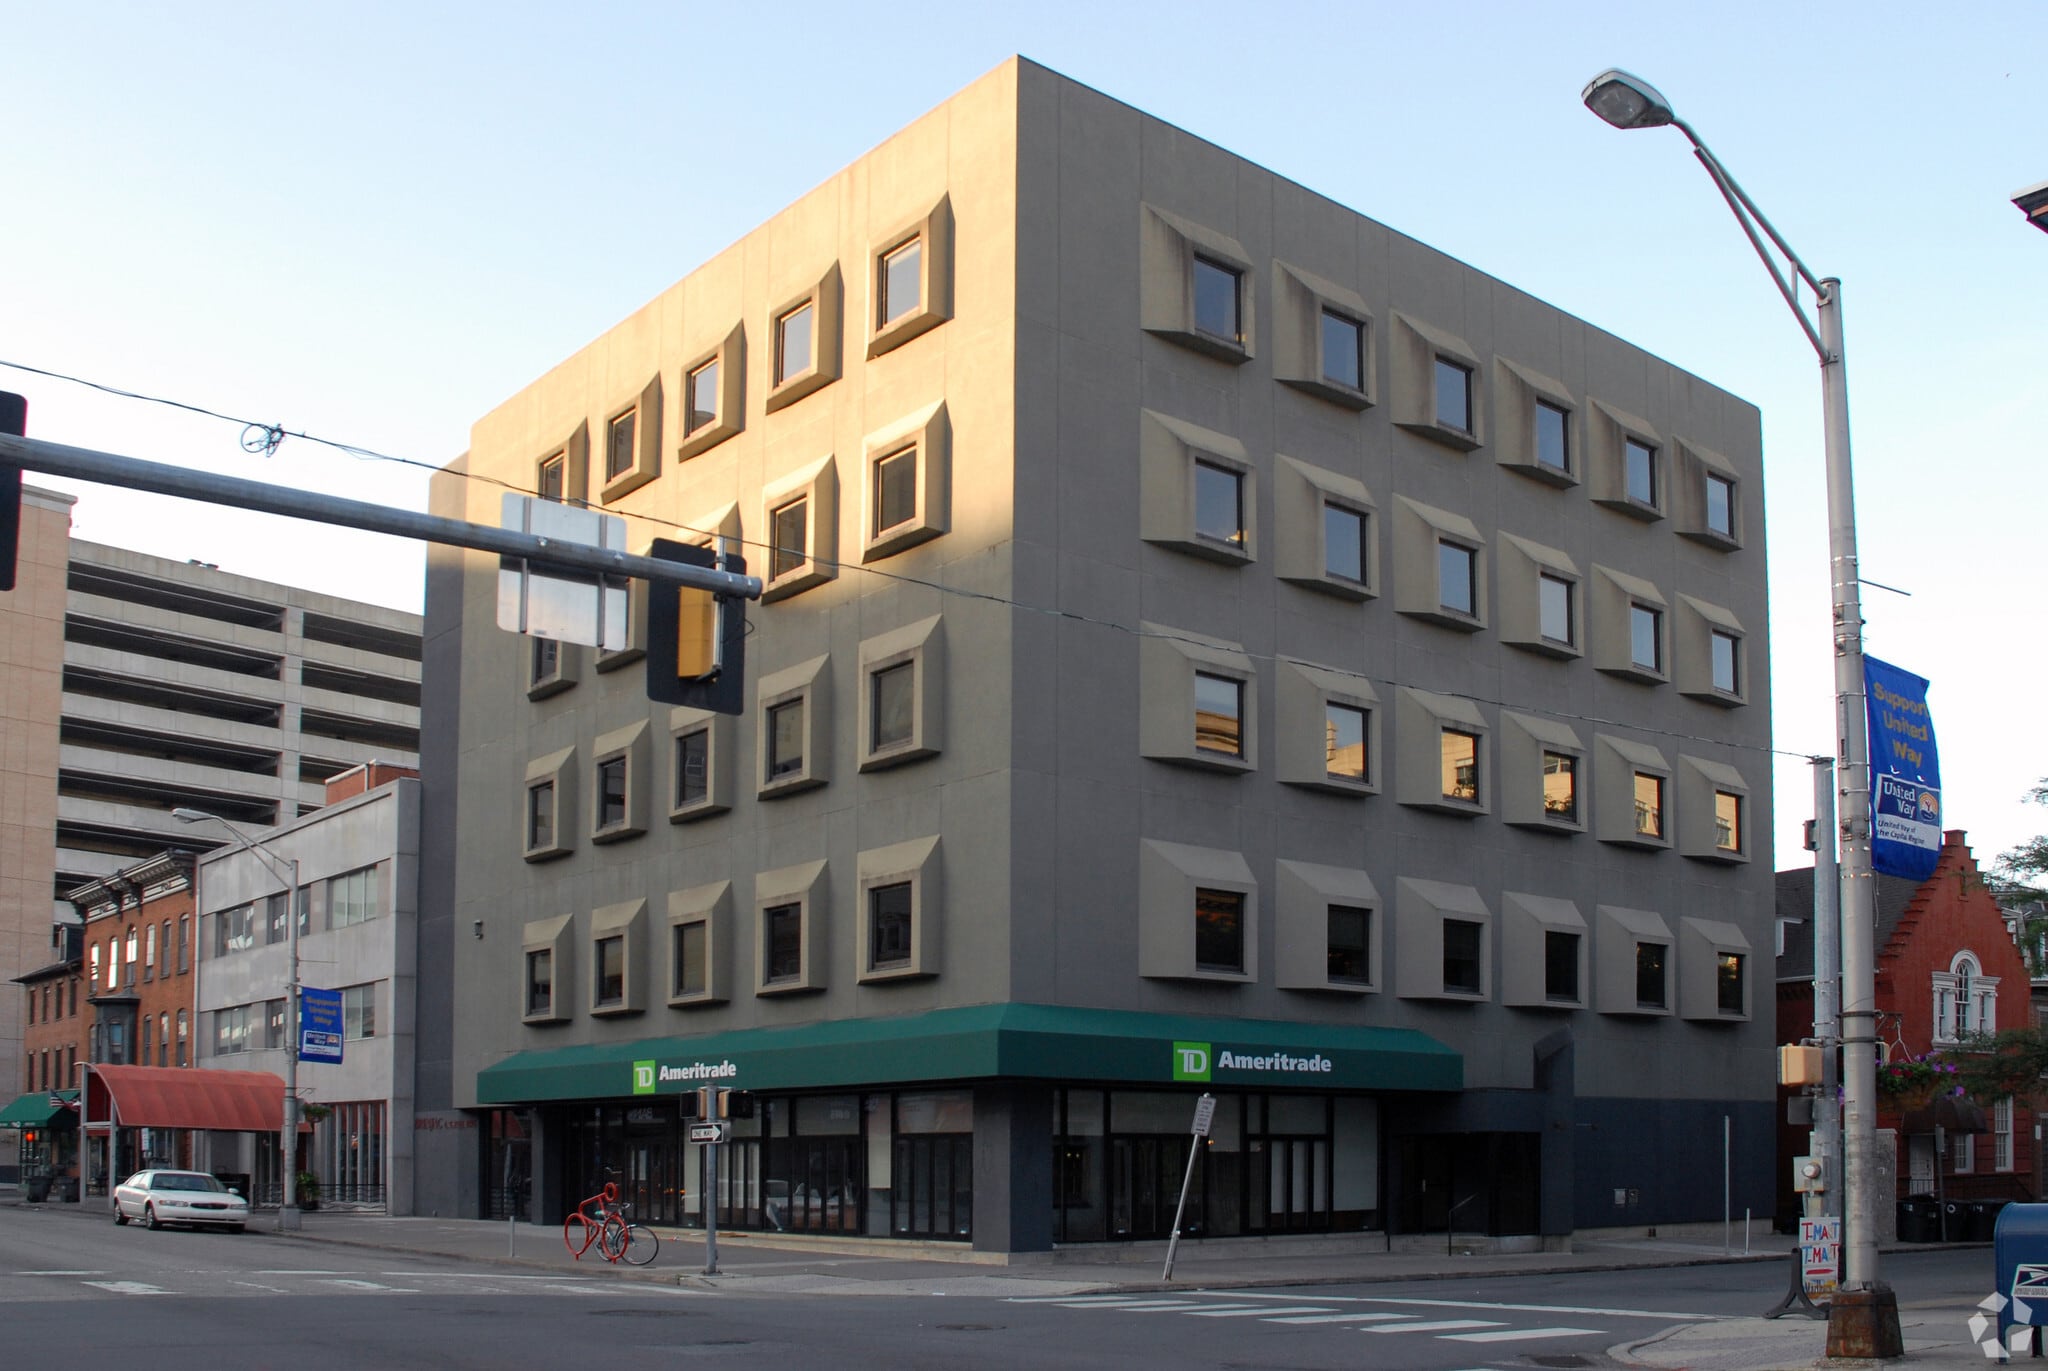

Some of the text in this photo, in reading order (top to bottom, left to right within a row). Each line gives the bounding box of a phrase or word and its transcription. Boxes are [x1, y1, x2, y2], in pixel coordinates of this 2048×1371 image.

[1873, 682, 1929, 718] Support
[1882, 709, 1929, 741] United
[1892, 738, 1922, 768] Way
[1884, 781, 1916, 802] United
[635, 1060, 737, 1088] TD Ameritrade
[1177, 1048, 1332, 1074] TD Ameritrade
